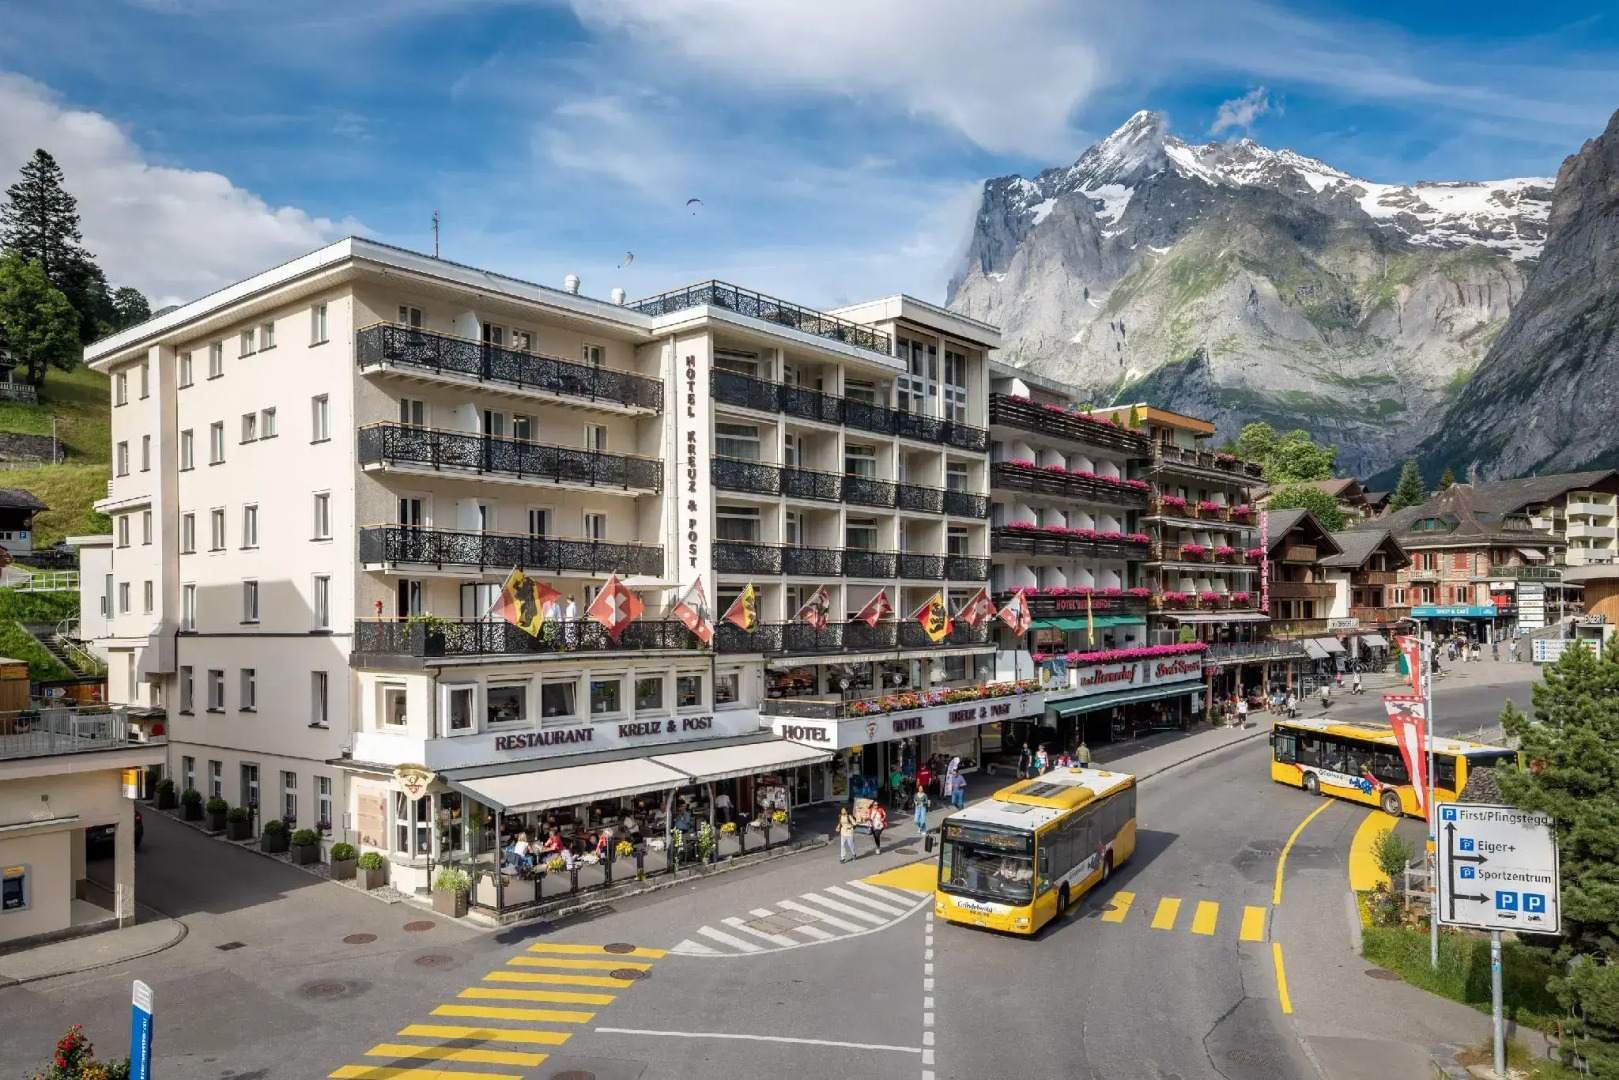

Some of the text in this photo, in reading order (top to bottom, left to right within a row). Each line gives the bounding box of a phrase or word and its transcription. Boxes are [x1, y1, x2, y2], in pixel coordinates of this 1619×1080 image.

[686, 355, 698, 568] HOTEL KREUZ & POST
[1056, 599, 1110, 610] HOTEL BERERHOF
[892, 717, 925, 733] HOTEL
[949, 708, 976, 724] KREUZ
[991, 703, 1011, 717] POST
[618, 717, 713, 738] KREUZ & POST
[782, 724, 830, 742] HOTEL
[495, 728, 594, 751] RESTAURANT
[1460, 810, 1548, 826] First/Pfingstegg
[1478, 841, 1516, 853] Eiger+
[1478, 869, 1551, 883] Sportzentrum
